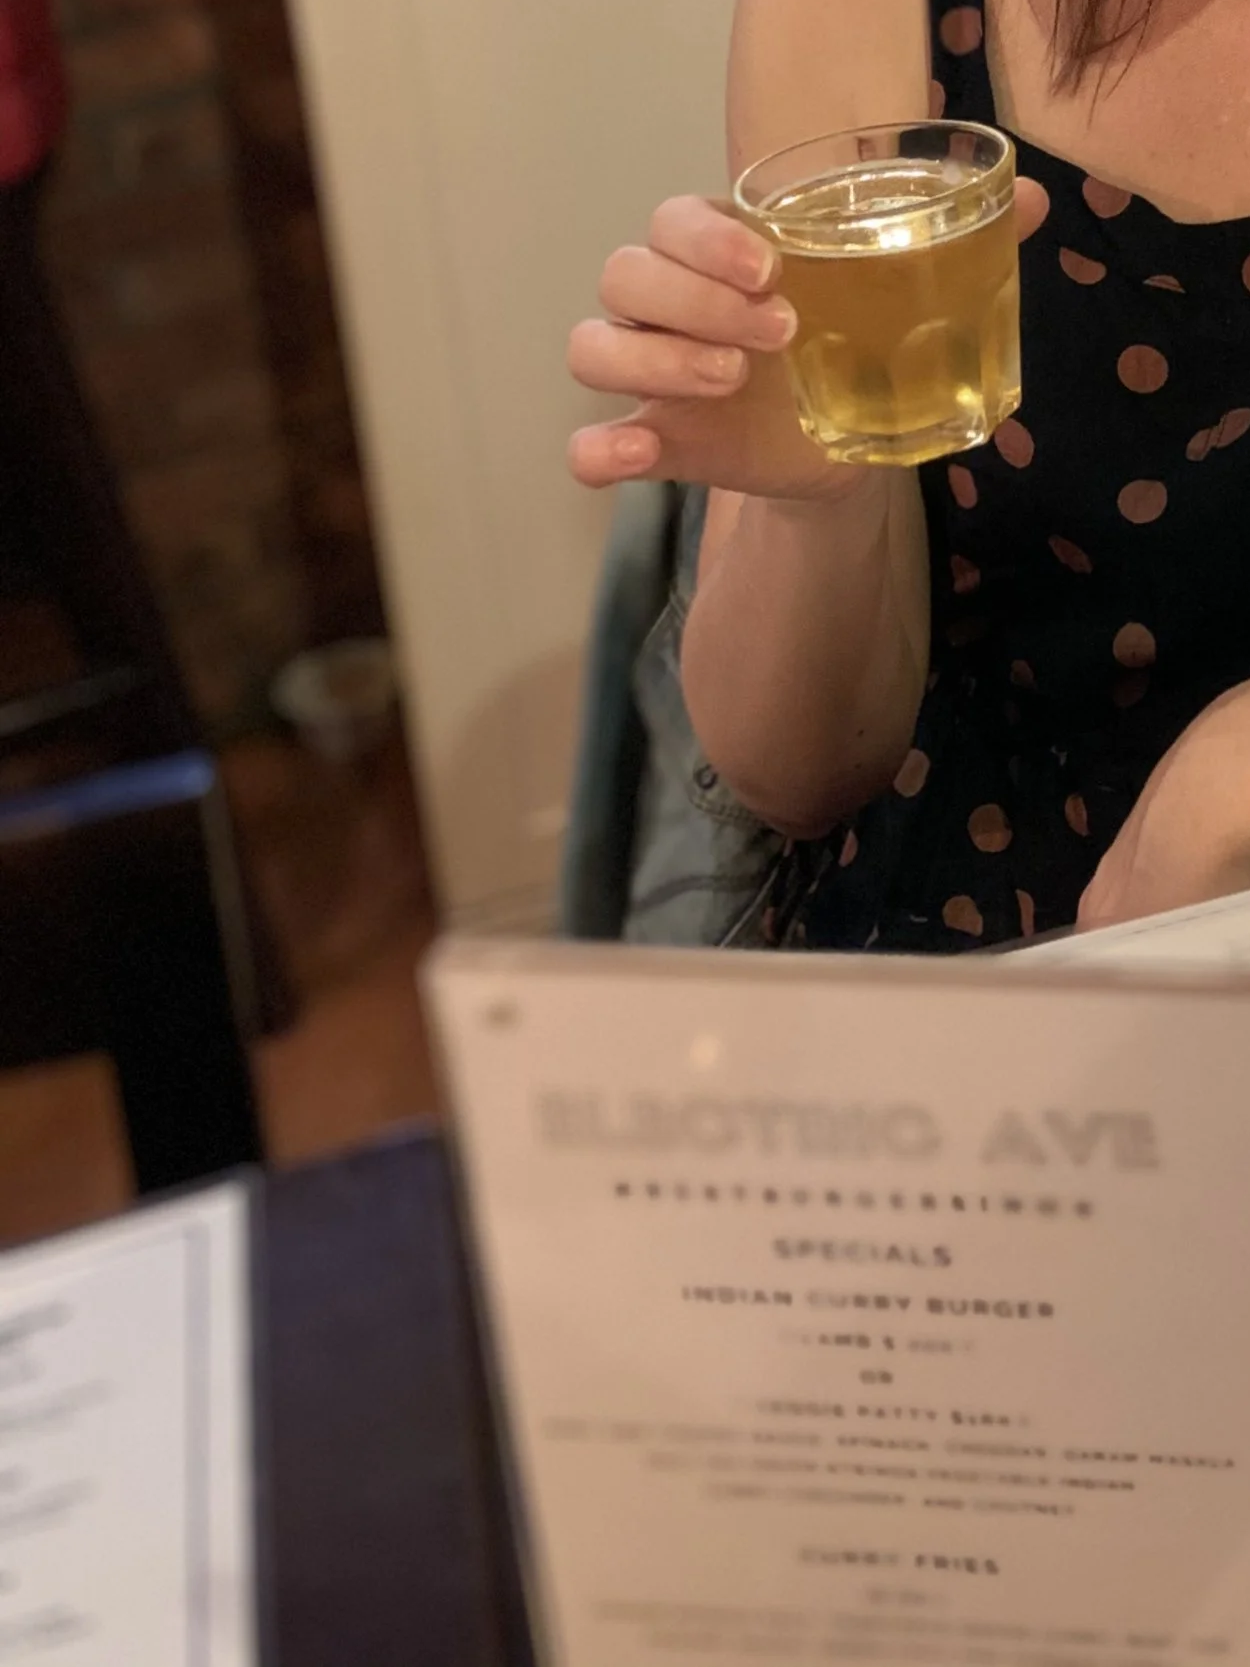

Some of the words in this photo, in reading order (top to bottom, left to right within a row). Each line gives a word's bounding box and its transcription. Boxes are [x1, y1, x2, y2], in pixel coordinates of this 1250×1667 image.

[981, 1111, 1161, 1172] AVE
[773, 1238, 953, 1268] SPECIALS
[682, 1286, 792, 1307] INDIAN
[806, 1290, 910, 1311] CURRY
[926, 1296, 1055, 1319] BURGER
[914, 1552, 1001, 1576] FRIES
